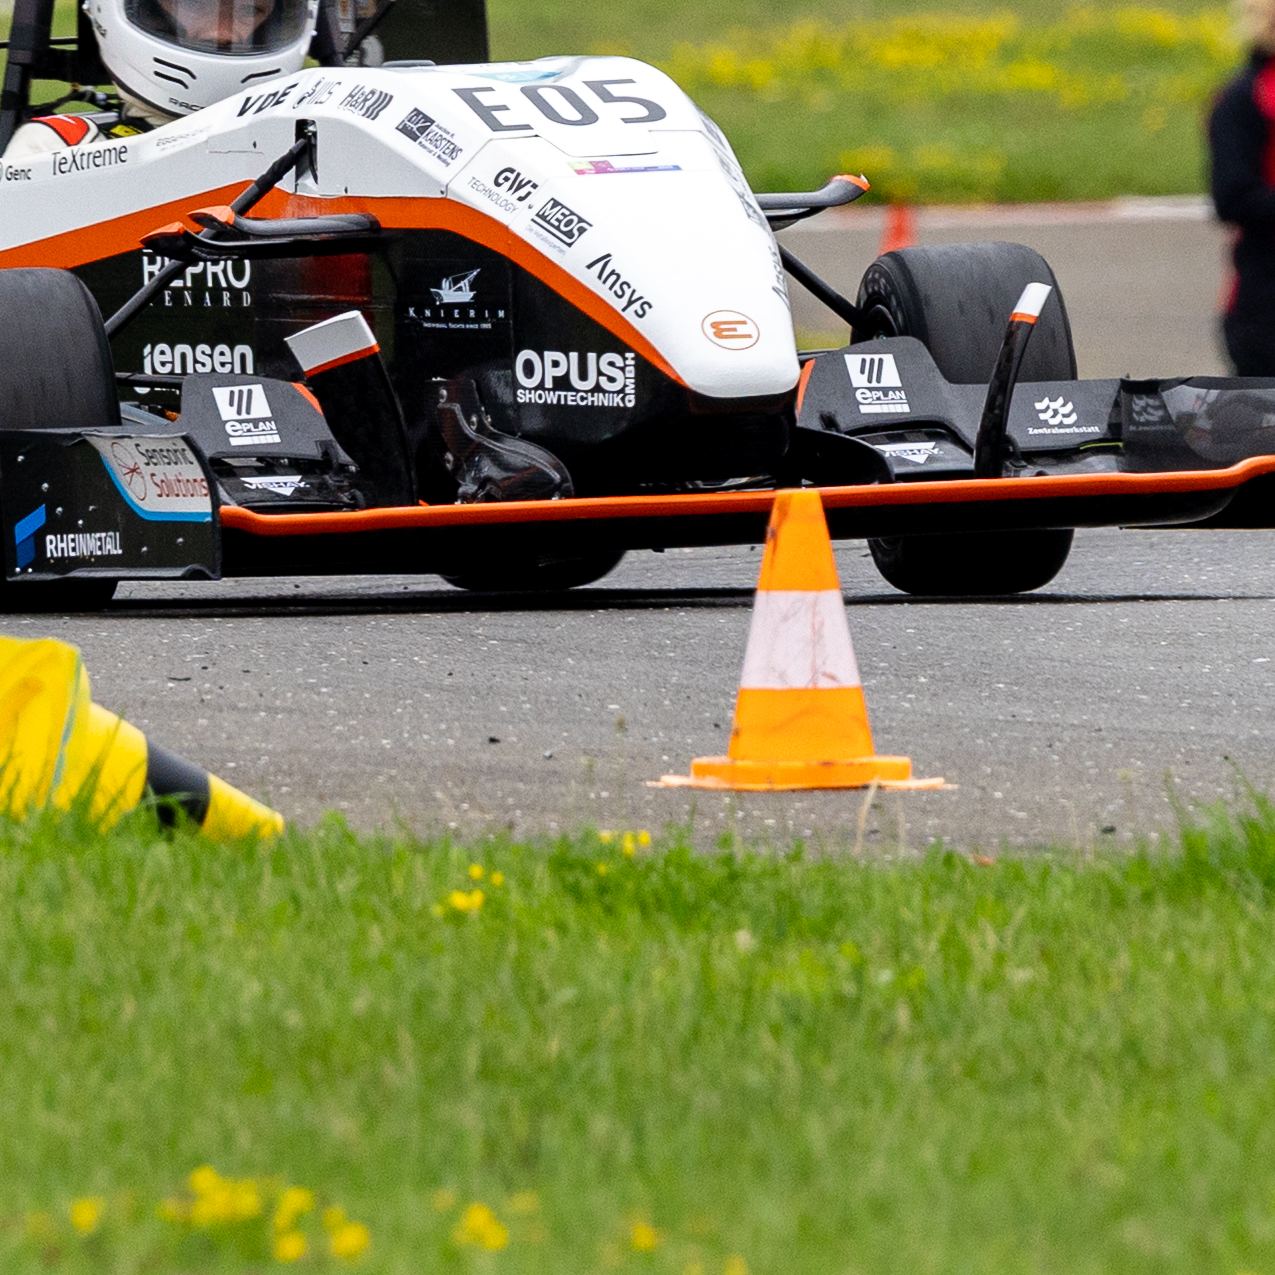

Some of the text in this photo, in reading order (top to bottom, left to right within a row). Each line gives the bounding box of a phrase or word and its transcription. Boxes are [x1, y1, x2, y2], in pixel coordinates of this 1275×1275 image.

[237, 82, 299, 118] VDE
[451, 78, 668, 133] E05
[423, 128, 463, 161] KARSTENS
[5, 165, 33, 181] Genc
[52, 144, 129, 176] TeXtreme
[467, 176, 520, 215] TECHNOLOGY
[537, 198, 590, 245] MEOS
[149, 290, 252, 307] ENARD
[584, 252, 654, 320] Ansys
[408, 307, 505, 319] KNIERIM
[515, 349, 625, 392] OPUS
[516, 389, 625, 408] SHOWTECHNIK
[1027, 426, 1101, 435] Zentralwerkstatt
[135, 442, 195, 466] Sensoric
[150, 472, 210, 498] Solutions
[46, 532, 123, 558] RHEINMETALL
